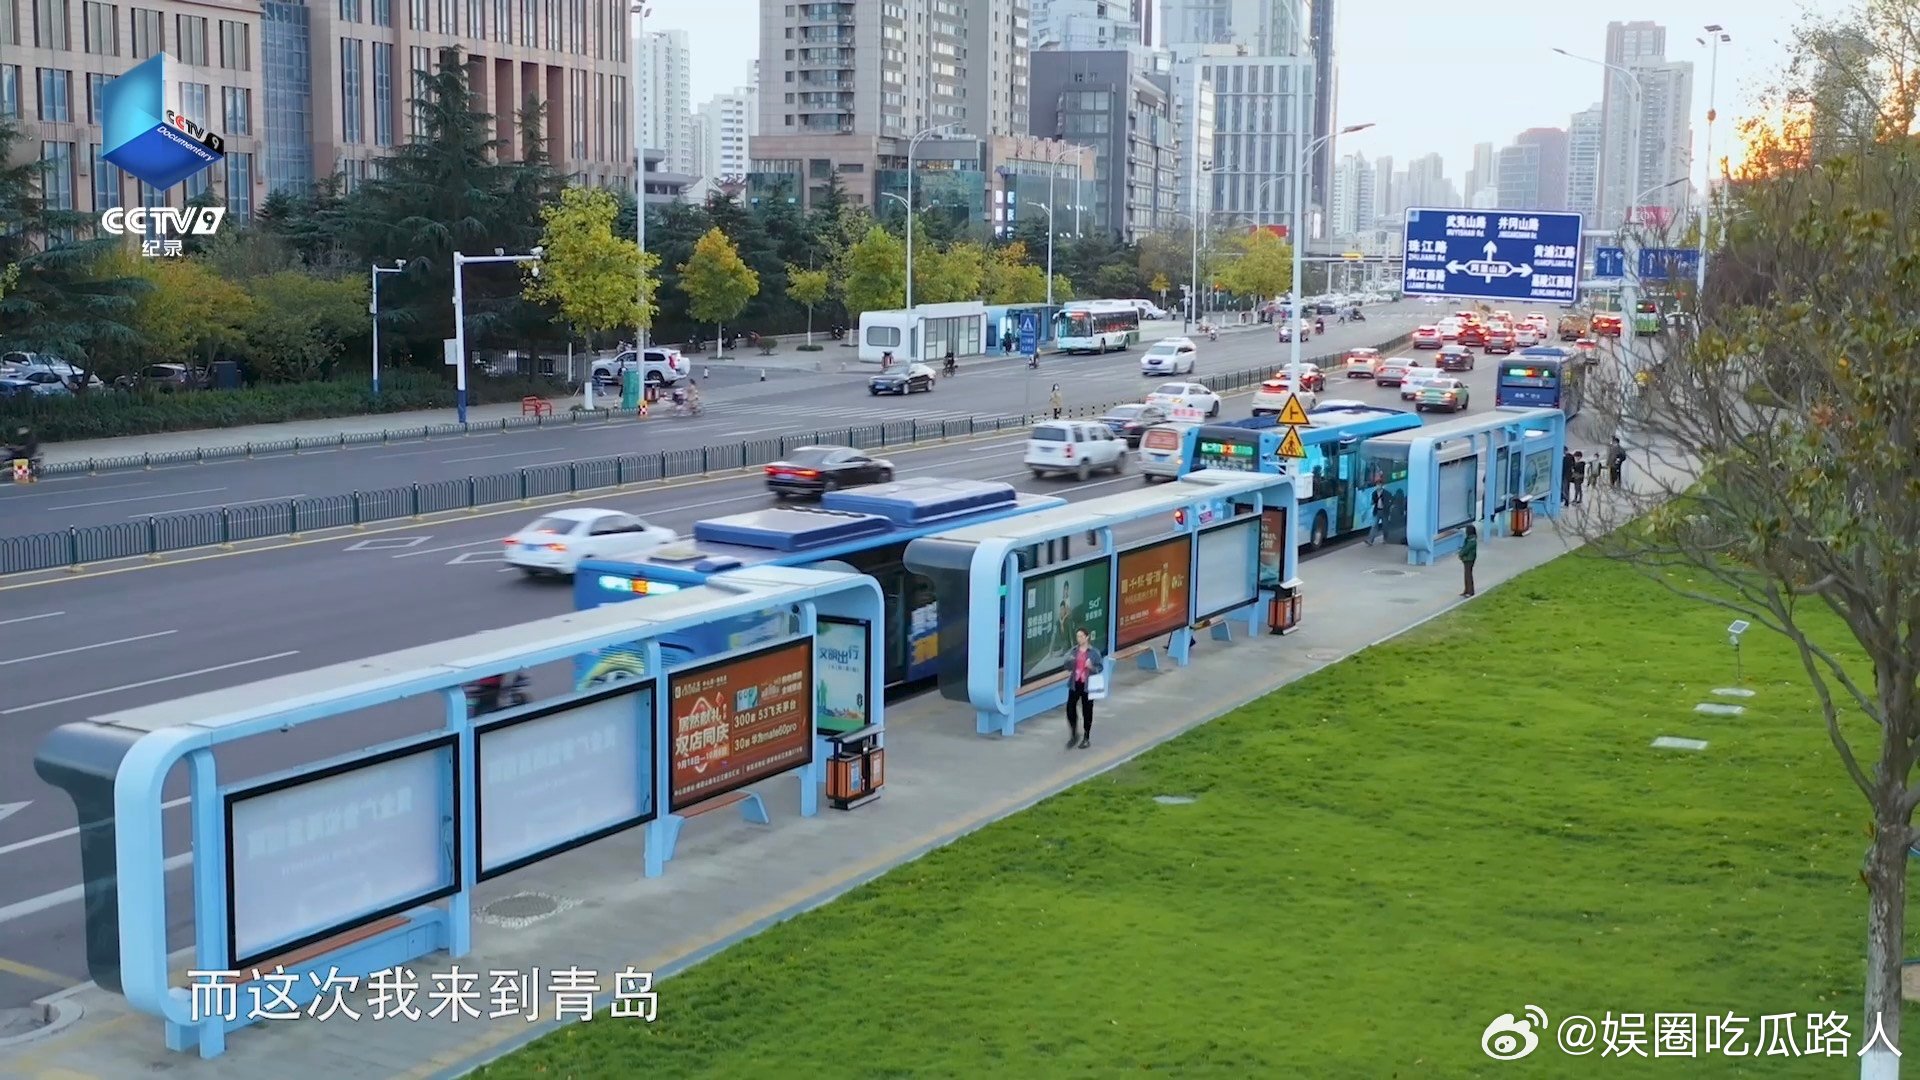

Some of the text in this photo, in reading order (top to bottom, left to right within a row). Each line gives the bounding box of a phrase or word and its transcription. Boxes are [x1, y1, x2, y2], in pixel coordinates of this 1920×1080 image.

[1446, 214, 1487, 231] 武夷山路
[1498, 216, 1540, 232] 井冈山路
[1408, 239, 1448, 255] 珠江路
[1534, 244, 1576, 260] 黄浦江路
[675, 723, 730, 758] 双店同庆
